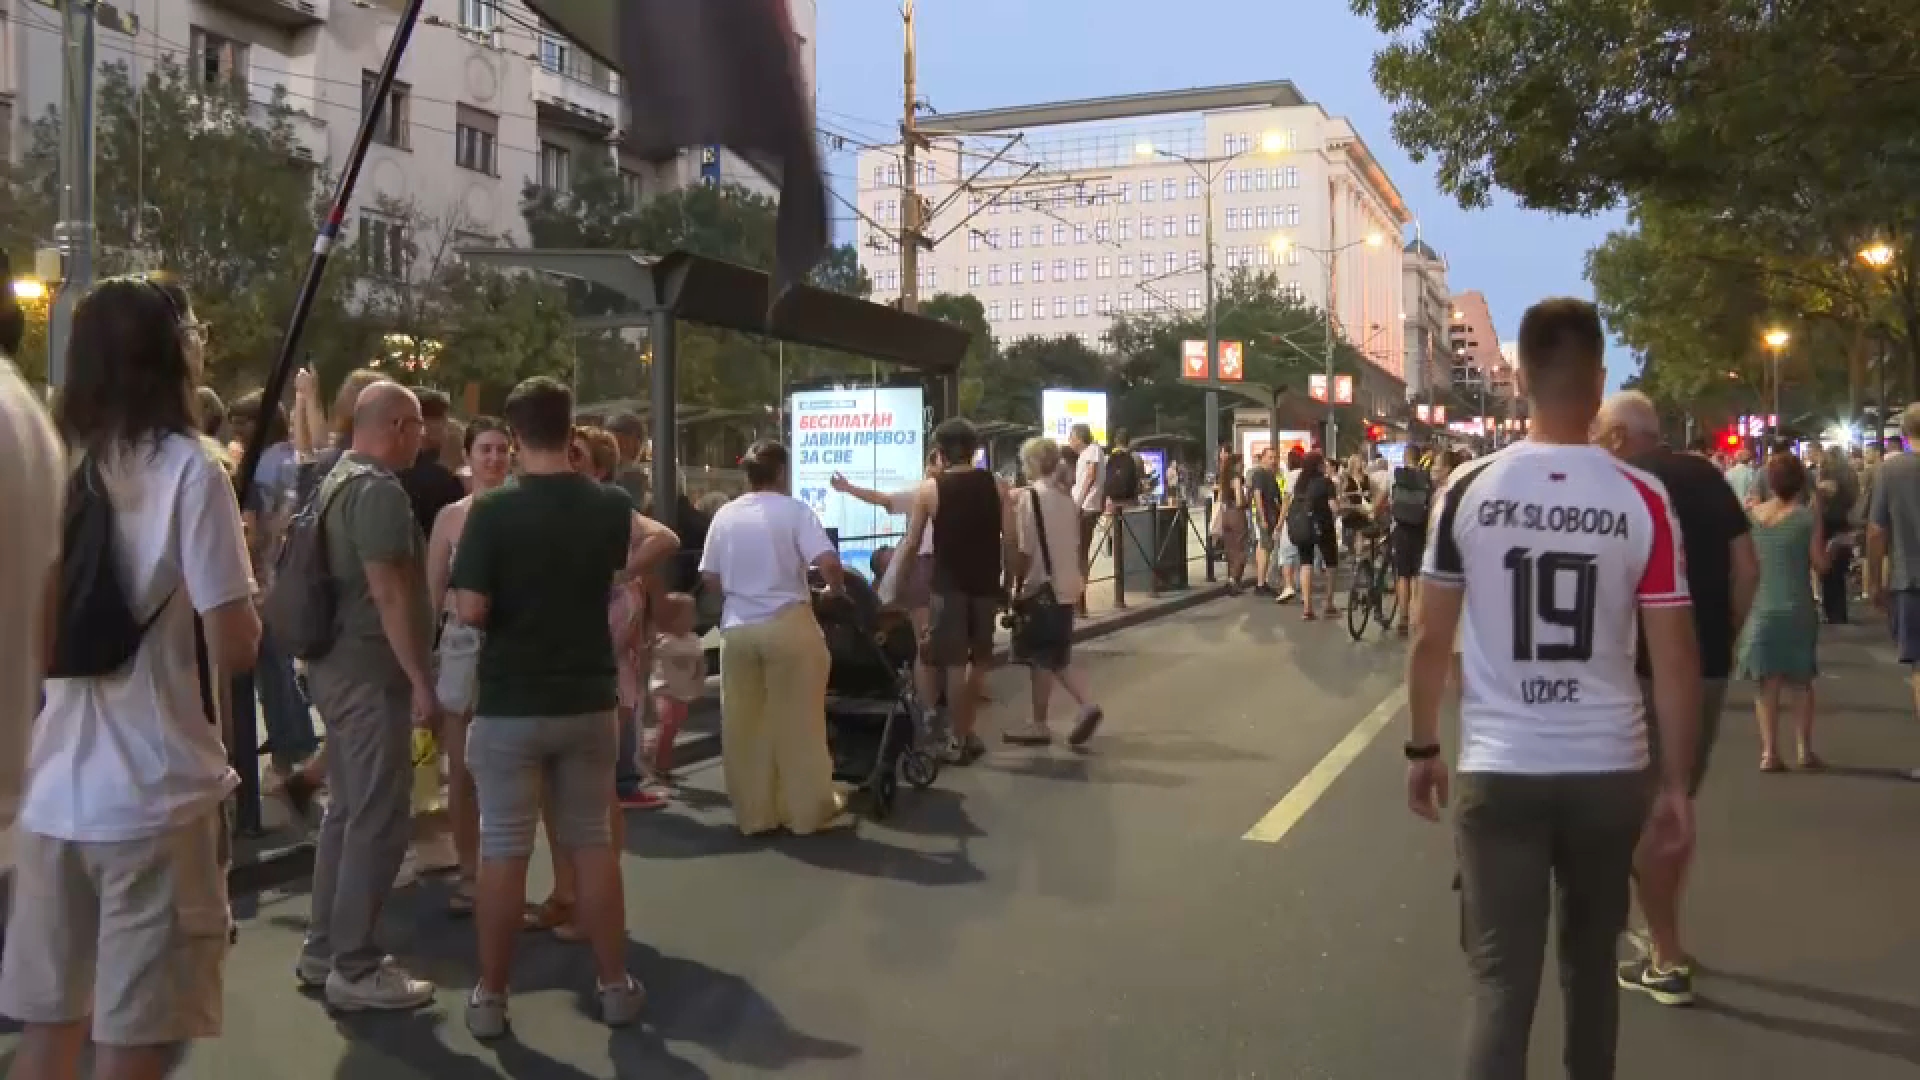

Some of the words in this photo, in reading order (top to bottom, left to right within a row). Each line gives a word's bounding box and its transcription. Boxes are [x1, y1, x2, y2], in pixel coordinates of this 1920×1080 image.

[800, 412, 893, 429] БЕСПЛАТАН
[800, 431, 851, 446] ЈАВНИ
[854, 430, 916, 445] ПРЕВОЗ
[800, 450, 818, 464] ЗА
[822, 450, 853, 464] СВЕ
[1478, 500, 1520, 527] GFK
[1523, 503, 1629, 539] SLOBODA
[1504, 546, 1598, 662] 19
[1521, 676, 1579, 704] UŽICE
